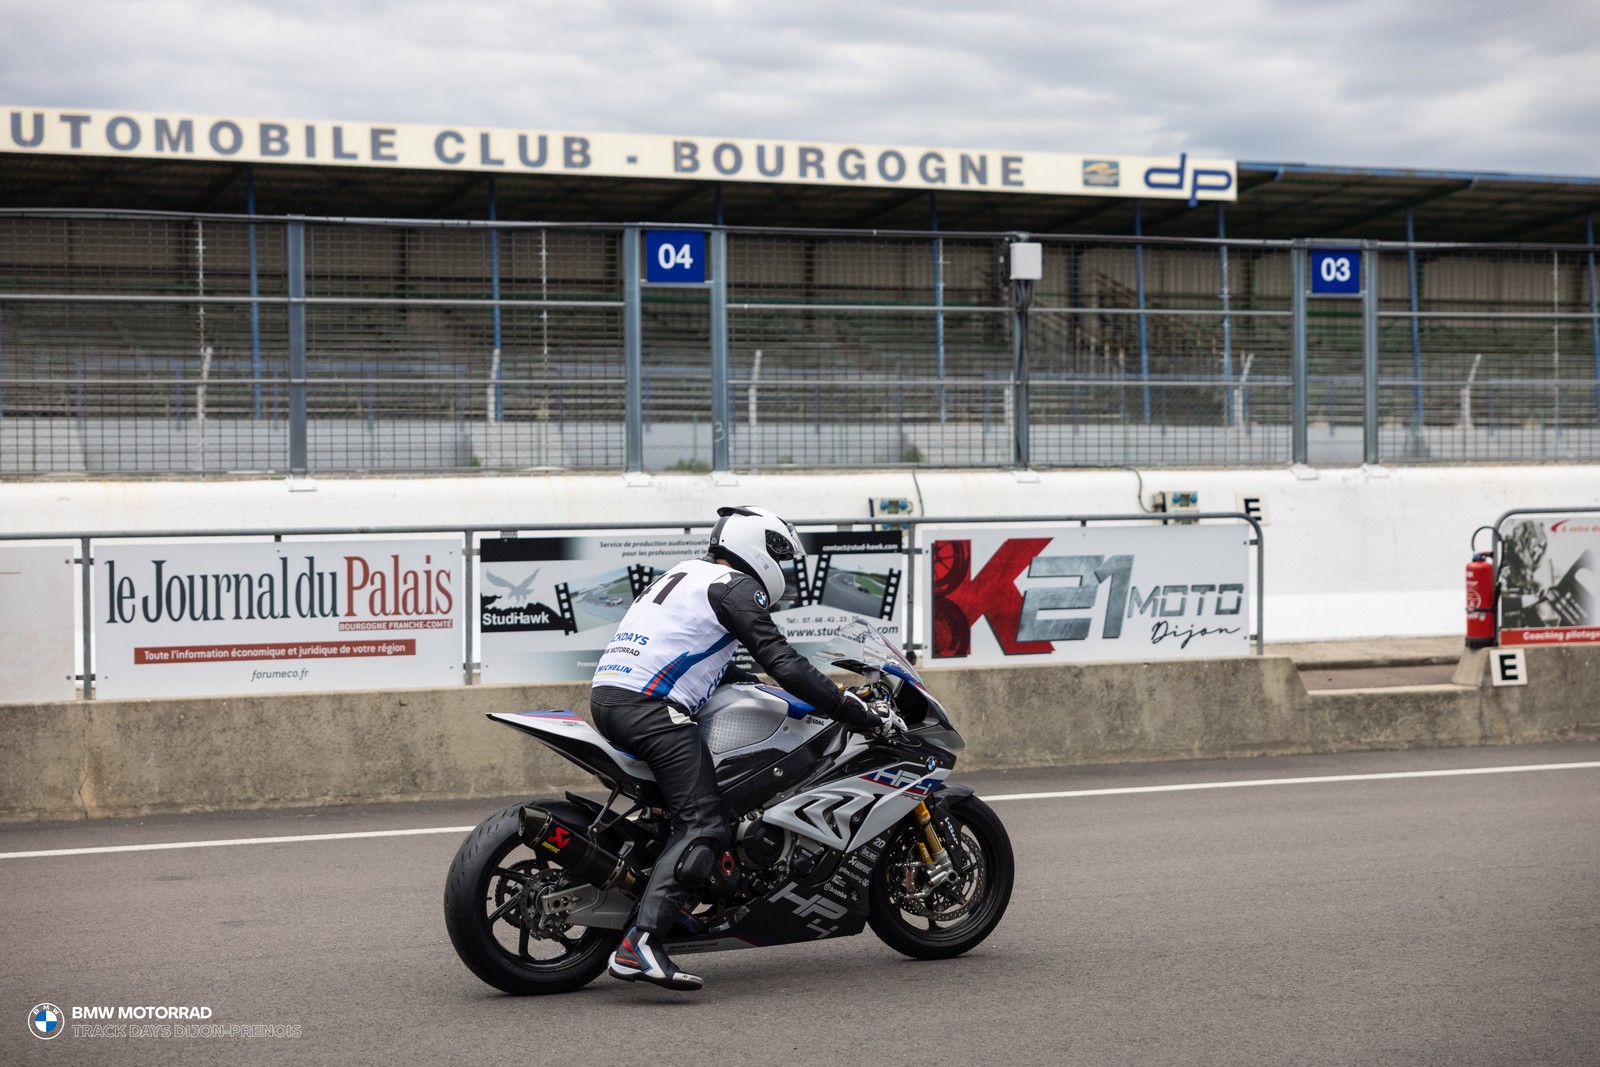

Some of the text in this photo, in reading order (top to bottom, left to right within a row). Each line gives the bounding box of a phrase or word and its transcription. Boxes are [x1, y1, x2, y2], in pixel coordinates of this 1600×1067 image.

[10, 111, 398, 162] UTOMOBILE
[433, 130, 592, 169] CLUB
[672, 140, 1026, 188] BOURGOGNE
[657, 242, 694, 270] 04
[1320, 256, 1352, 282] 03
[1243, 497, 1262, 521] E
[622, 550, 637, 558] pour
[638, 548, 647, 557] les
[648, 547, 693, 558] professionnels
[623, 540, 632, 548] de
[632, 539, 667, 549] production
[105, 554, 453, 624] le Journal du Palais
[931, 537, 1135, 659] K21
[1127, 583, 1245, 618] MOTO
[340, 622, 387, 631] BOURGOGNE
[1150, 620, 1241, 649] Dijon
[1522, 631, 1564, 641] Coaching
[144, 642, 406, 661] Toute l'information économique et juridique de votre région
[610, 646, 640, 656] MOTORRAD
[250, 667, 310, 681] forumeco.fr
[598, 664, 633, 674] MICHELIN
[1499, 653, 1519, 681] E
[872, 837, 886, 849] 2D
